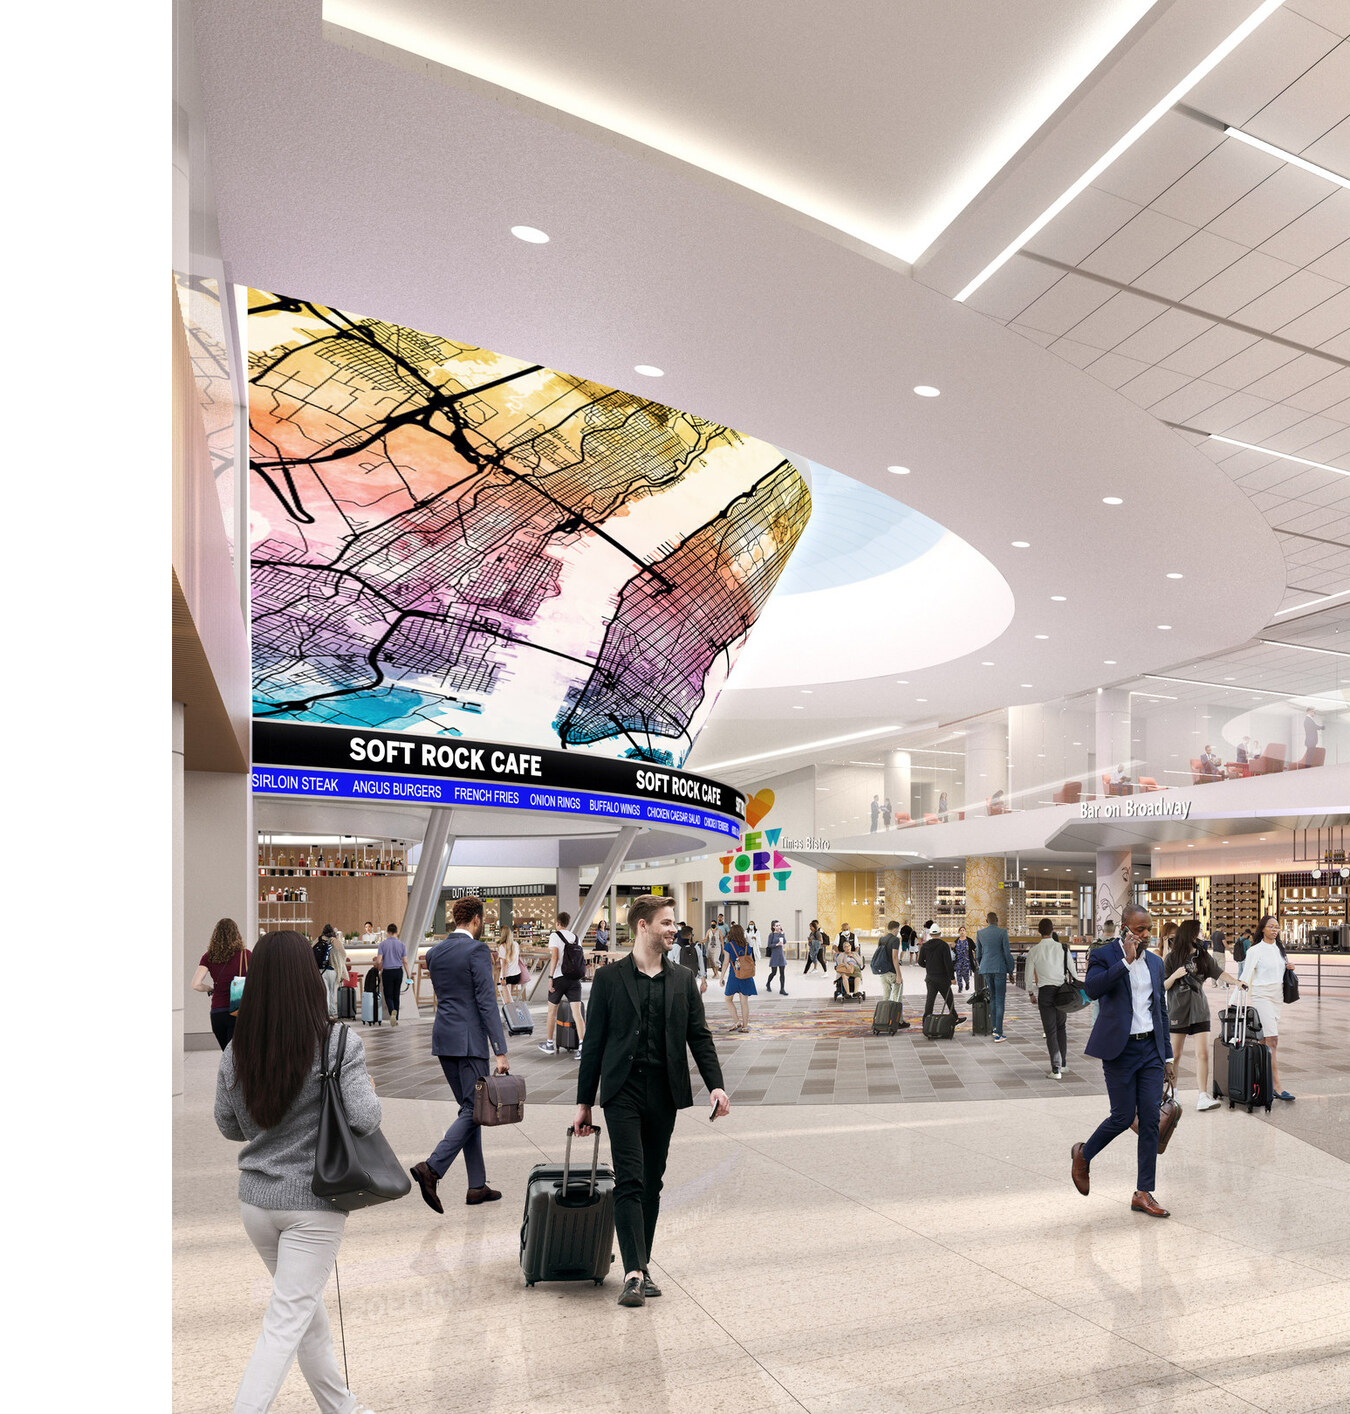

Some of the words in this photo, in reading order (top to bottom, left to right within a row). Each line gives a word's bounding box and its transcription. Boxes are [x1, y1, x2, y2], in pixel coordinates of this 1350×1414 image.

[350, 737, 415, 765] SOFT
[421, 744, 485, 771] ROCK
[491, 751, 542, 777] CAFE
[252, 773, 298, 789] SIRLOIN
[301, 777, 339, 792] STEAK
[352, 780, 390, 795] ANGUS
[393, 782, 442, 798] BURGERS
[636, 769, 670, 793] SOFT
[672, 776, 700, 800] ROCK
[701, 784, 721, 806] CAFE
[454, 787, 492, 802] FRENCH
[494, 790, 519, 804] FRIES
[530, 794, 555, 807] ONION
[557, 796, 581, 809] RINGS
[589, 799, 619, 813] BUFFALO
[620, 803, 641, 816] WINGS
[647, 806, 670, 820] CHICKEN
[670, 810, 688, 822] CAESAR
[688, 813, 701, 825] SALAD
[1080, 802, 1101, 819] Bar
[1104, 804, 1121, 818] on
[1126, 797, 1191, 820] Broadway
[781, 836, 804, 850] Times
[806, 836, 831, 850] Bistro
[719, 850, 791, 874] YORK
[719, 871, 792, 894] CITY
[452, 887, 465, 899] DUTY
[466, 886, 480, 898] FREE
